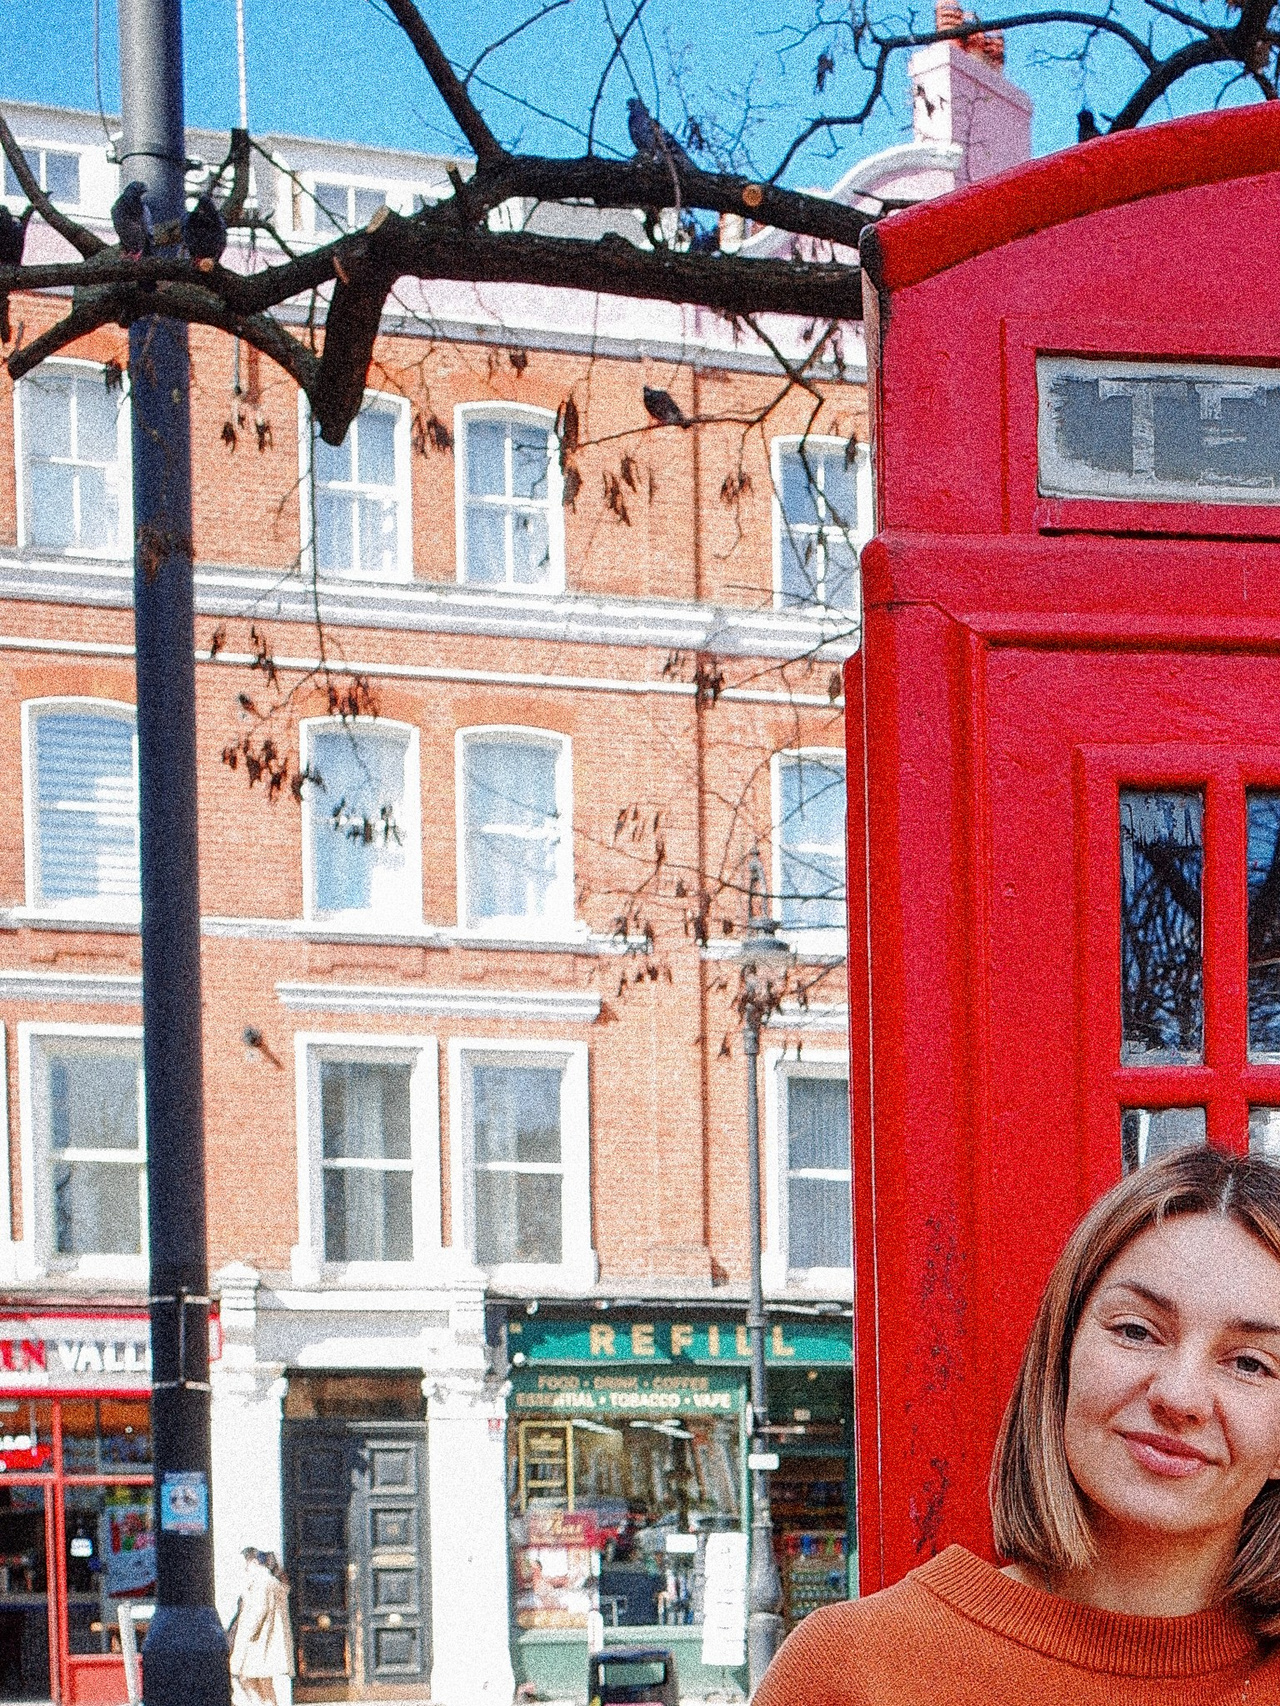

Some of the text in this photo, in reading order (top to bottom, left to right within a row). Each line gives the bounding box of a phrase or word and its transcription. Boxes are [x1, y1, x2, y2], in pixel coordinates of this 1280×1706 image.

[589, 1323, 795, 1357] REFILL
[537, 1375, 709, 1391] FOOD DRINK COFFEE
[610, 1392, 681, 1408] TOBACCO
[693, 1393, 731, 1408] VAPE
